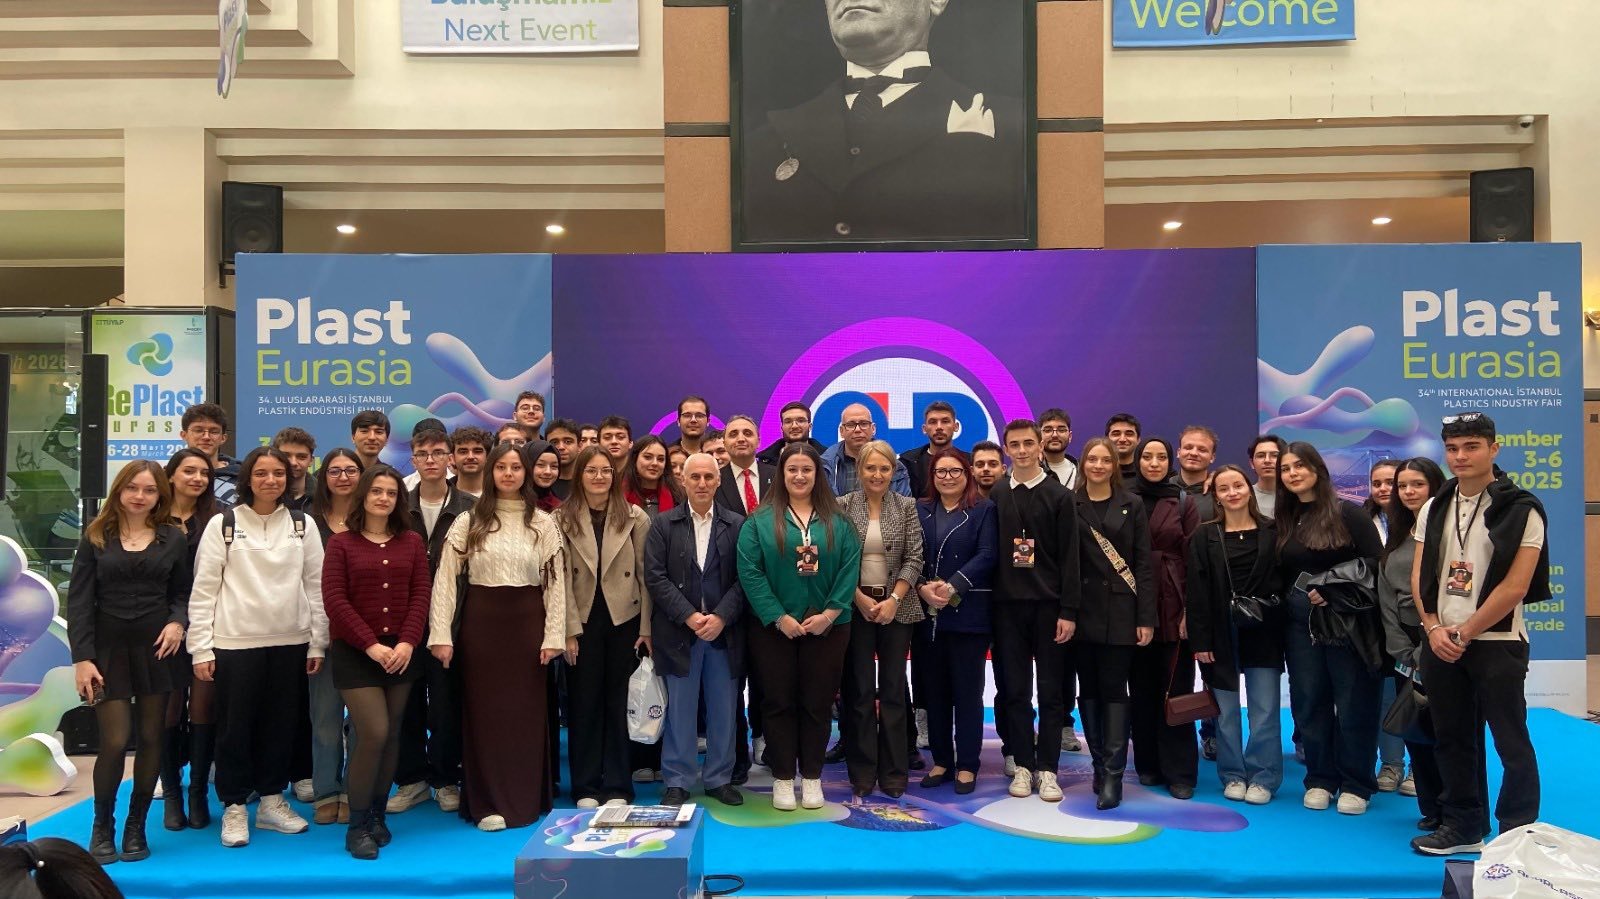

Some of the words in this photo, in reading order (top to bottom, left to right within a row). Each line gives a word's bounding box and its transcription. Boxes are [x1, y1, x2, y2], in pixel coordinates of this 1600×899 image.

[1129, 0, 1338, 28] Wecome
[445, 18, 510, 41] Next
[520, 17, 597, 41] Event
[1402, 288, 1560, 336] Plast
[256, 297, 411, 345] Plast
[257, 350, 412, 386] Eurasia
[1403, 341, 1560, 379] Eurasia
[258, 396, 272, 404] 34.
[275, 395, 347, 404] ULUSLARARASI
[349, 393, 394, 404] İSTANBUL
[1438, 389, 1514, 397] INTERNATIONAL
[1516, 386, 1562, 396] İSTANBUL
[258, 405, 297, 415] PLASTİK
[300, 405, 355, 415] ENDÜSTRİSİ
[1444, 400, 1489, 408] PLASTICS
[1492, 400, 1538, 408] INDUSTRY
[1541, 399, 1562, 407] FAIR
[1495, 430, 1562, 447] ember
[107, 444, 139, 457] 6-28
[1524, 451, 1562, 468] 3-6
[1506, 471, 1562, 489] 2025
[1524, 600, 1565, 613] lobal
[1523, 618, 1565, 631] rade
